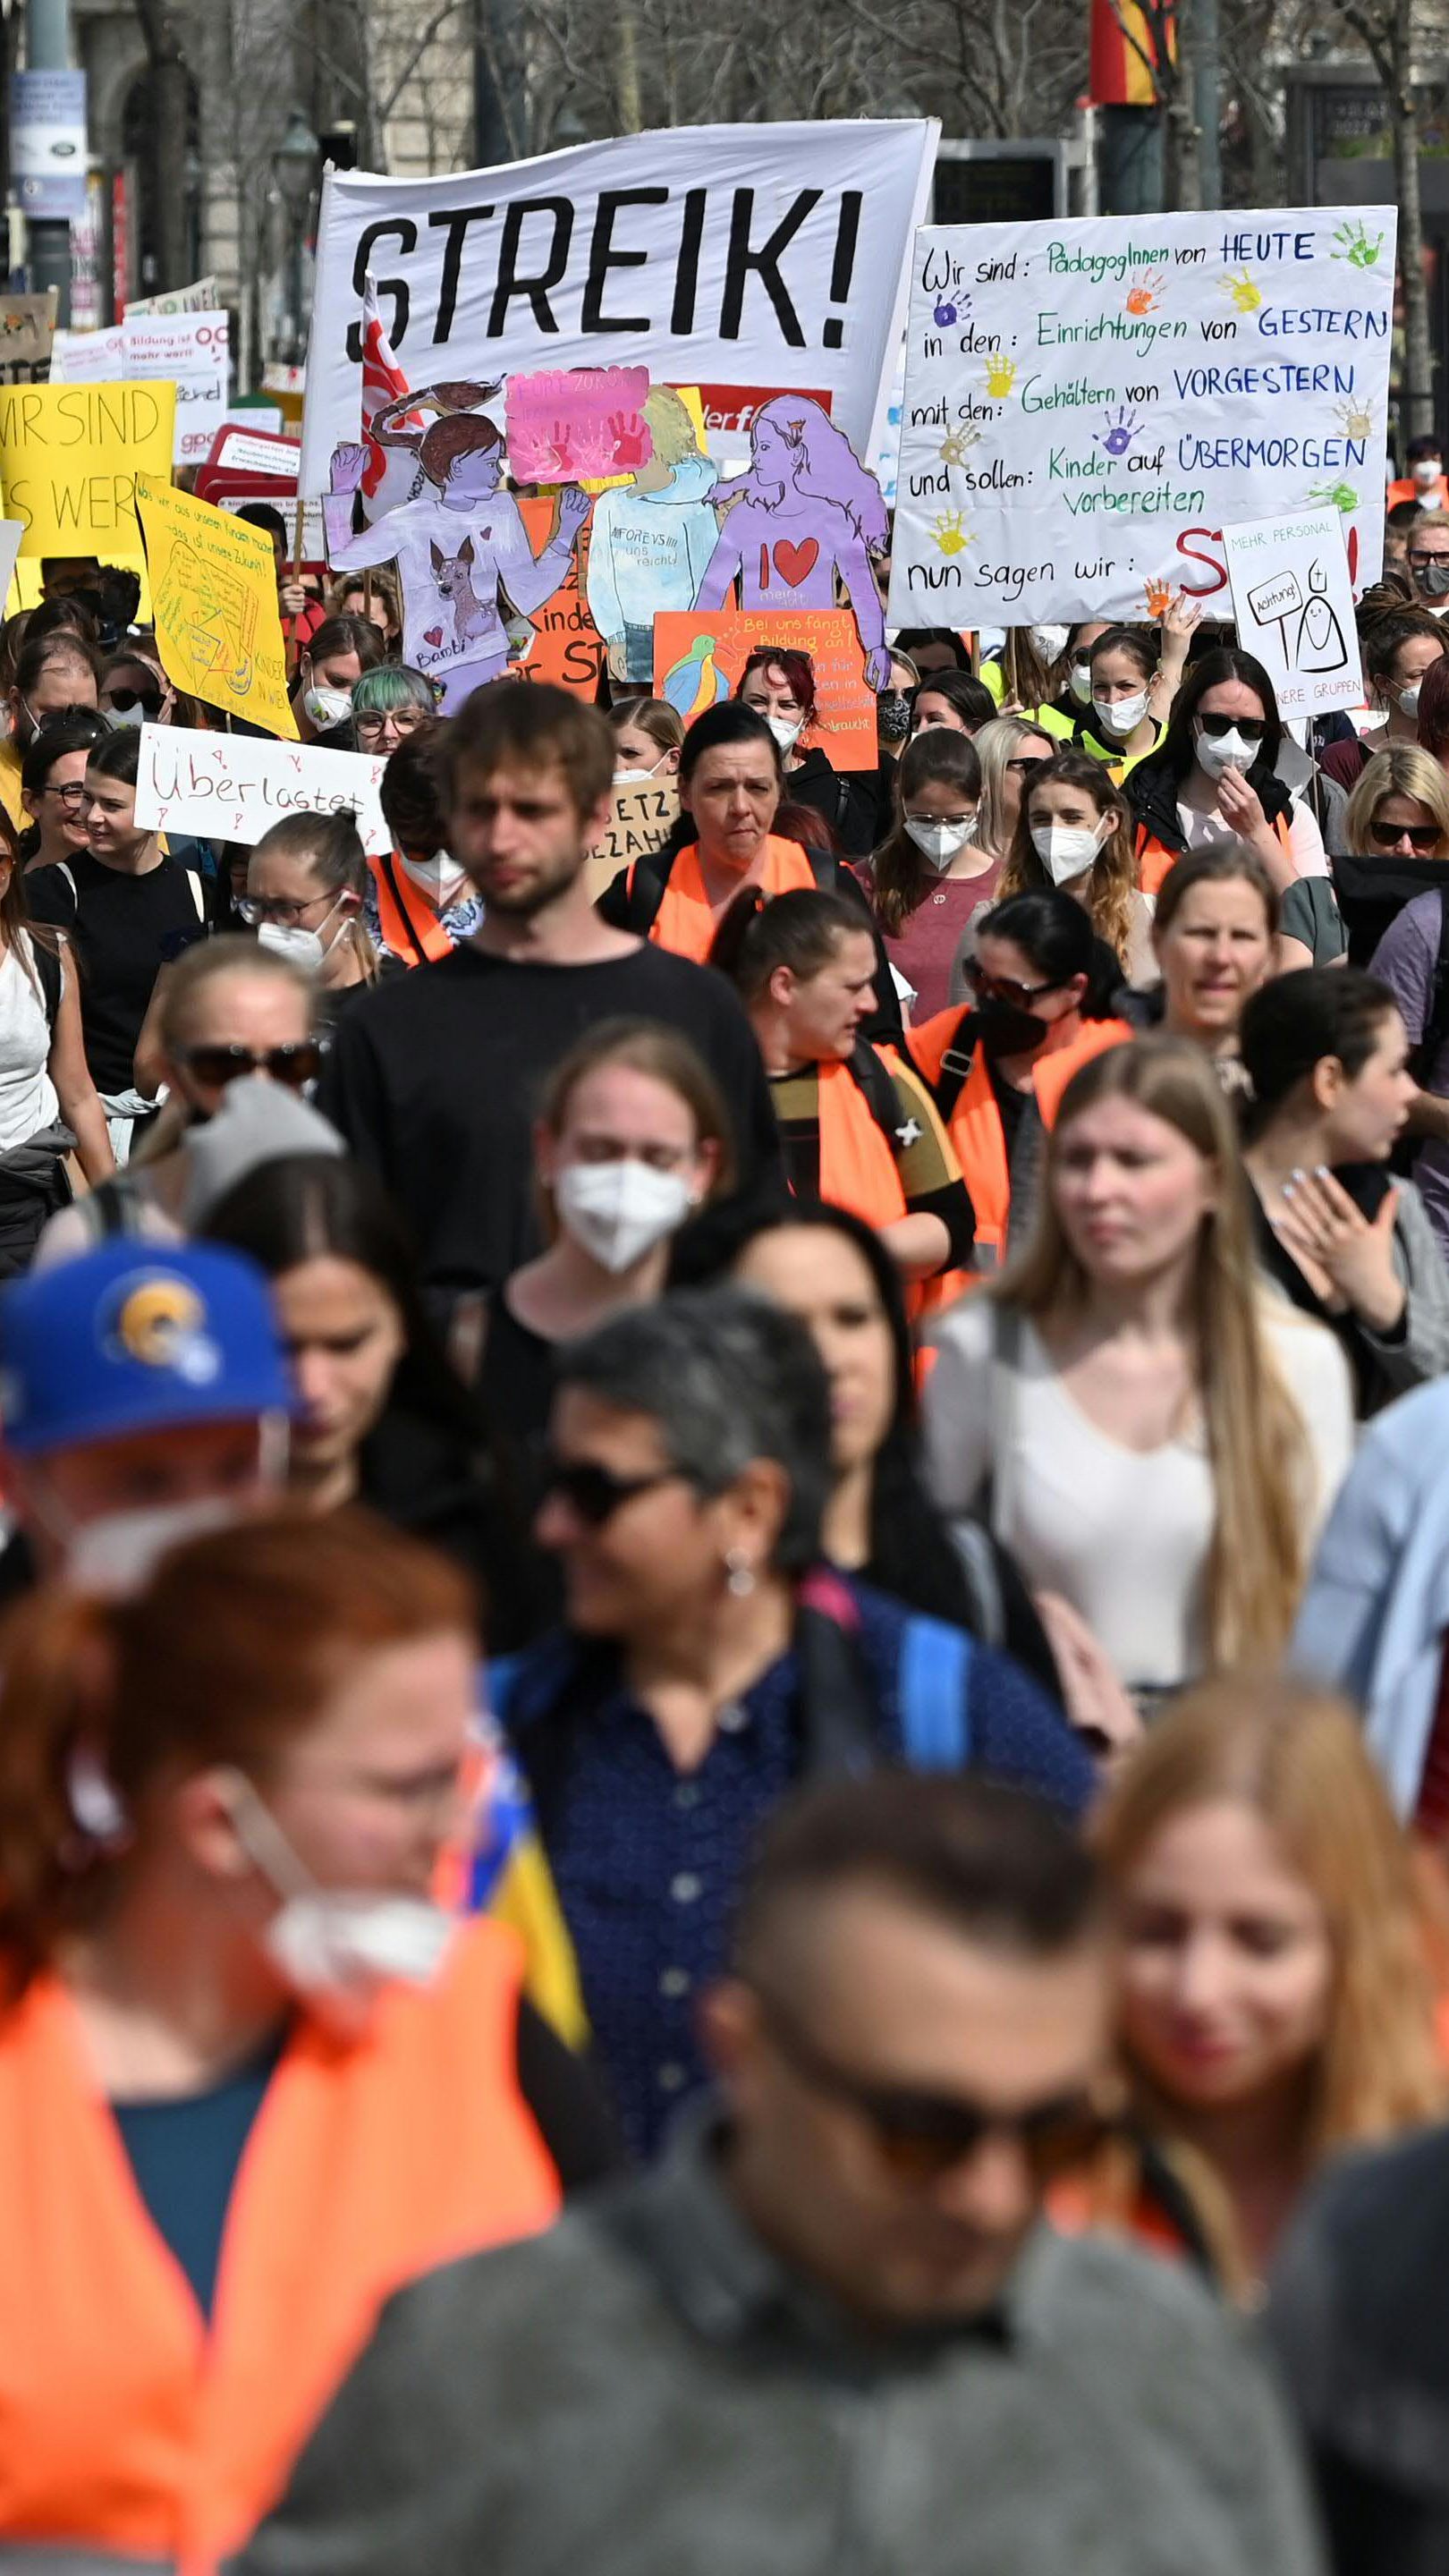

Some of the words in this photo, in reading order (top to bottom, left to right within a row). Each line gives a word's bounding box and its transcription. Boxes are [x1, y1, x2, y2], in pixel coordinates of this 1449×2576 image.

[345, 187, 863, 363] STREIK!
[922, 248, 965, 292] Wir
[1046, 242, 1169, 283] PädagogInnen
[1174, 247, 1206, 266] von
[1219, 233, 1316, 263] HEUTE
[924, 332, 942, 359] in
[1038, 312, 1187, 358] Einrichtungen
[1200, 320, 1237, 342] von
[1258, 307, 1388, 340] GESTERN
[57, 390, 159, 445] SIND
[911, 395, 949, 427] mit
[1021, 374, 1115, 413] Gehältern
[1125, 385, 1159, 402] von
[1174, 364, 1354, 400] VORGESTERN
[910, 464, 950, 496] und
[1048, 446, 1117, 479] Kinder
[1127, 445, 1165, 476] auf
[1178, 434, 1367, 471] ÜBERMORGEN
[51, 475, 165, 529] WER
[1232, 531, 1267, 551] MEHR
[1273, 521, 1334, 542] PERSONAL
[908, 564, 962, 590] nun
[974, 562, 1055, 602] sagen
[743, 618, 768, 633] Bei
[776, 619, 802, 631] uns
[759, 634, 818, 654] Bildung
[416, 639, 467, 669] Bambi
[1276, 689, 1306, 705] NERE
[1313, 680, 1361, 699] GRUPPEN
[152, 740, 365, 816] Überlastet
[616, 789, 679, 821] ETZ
